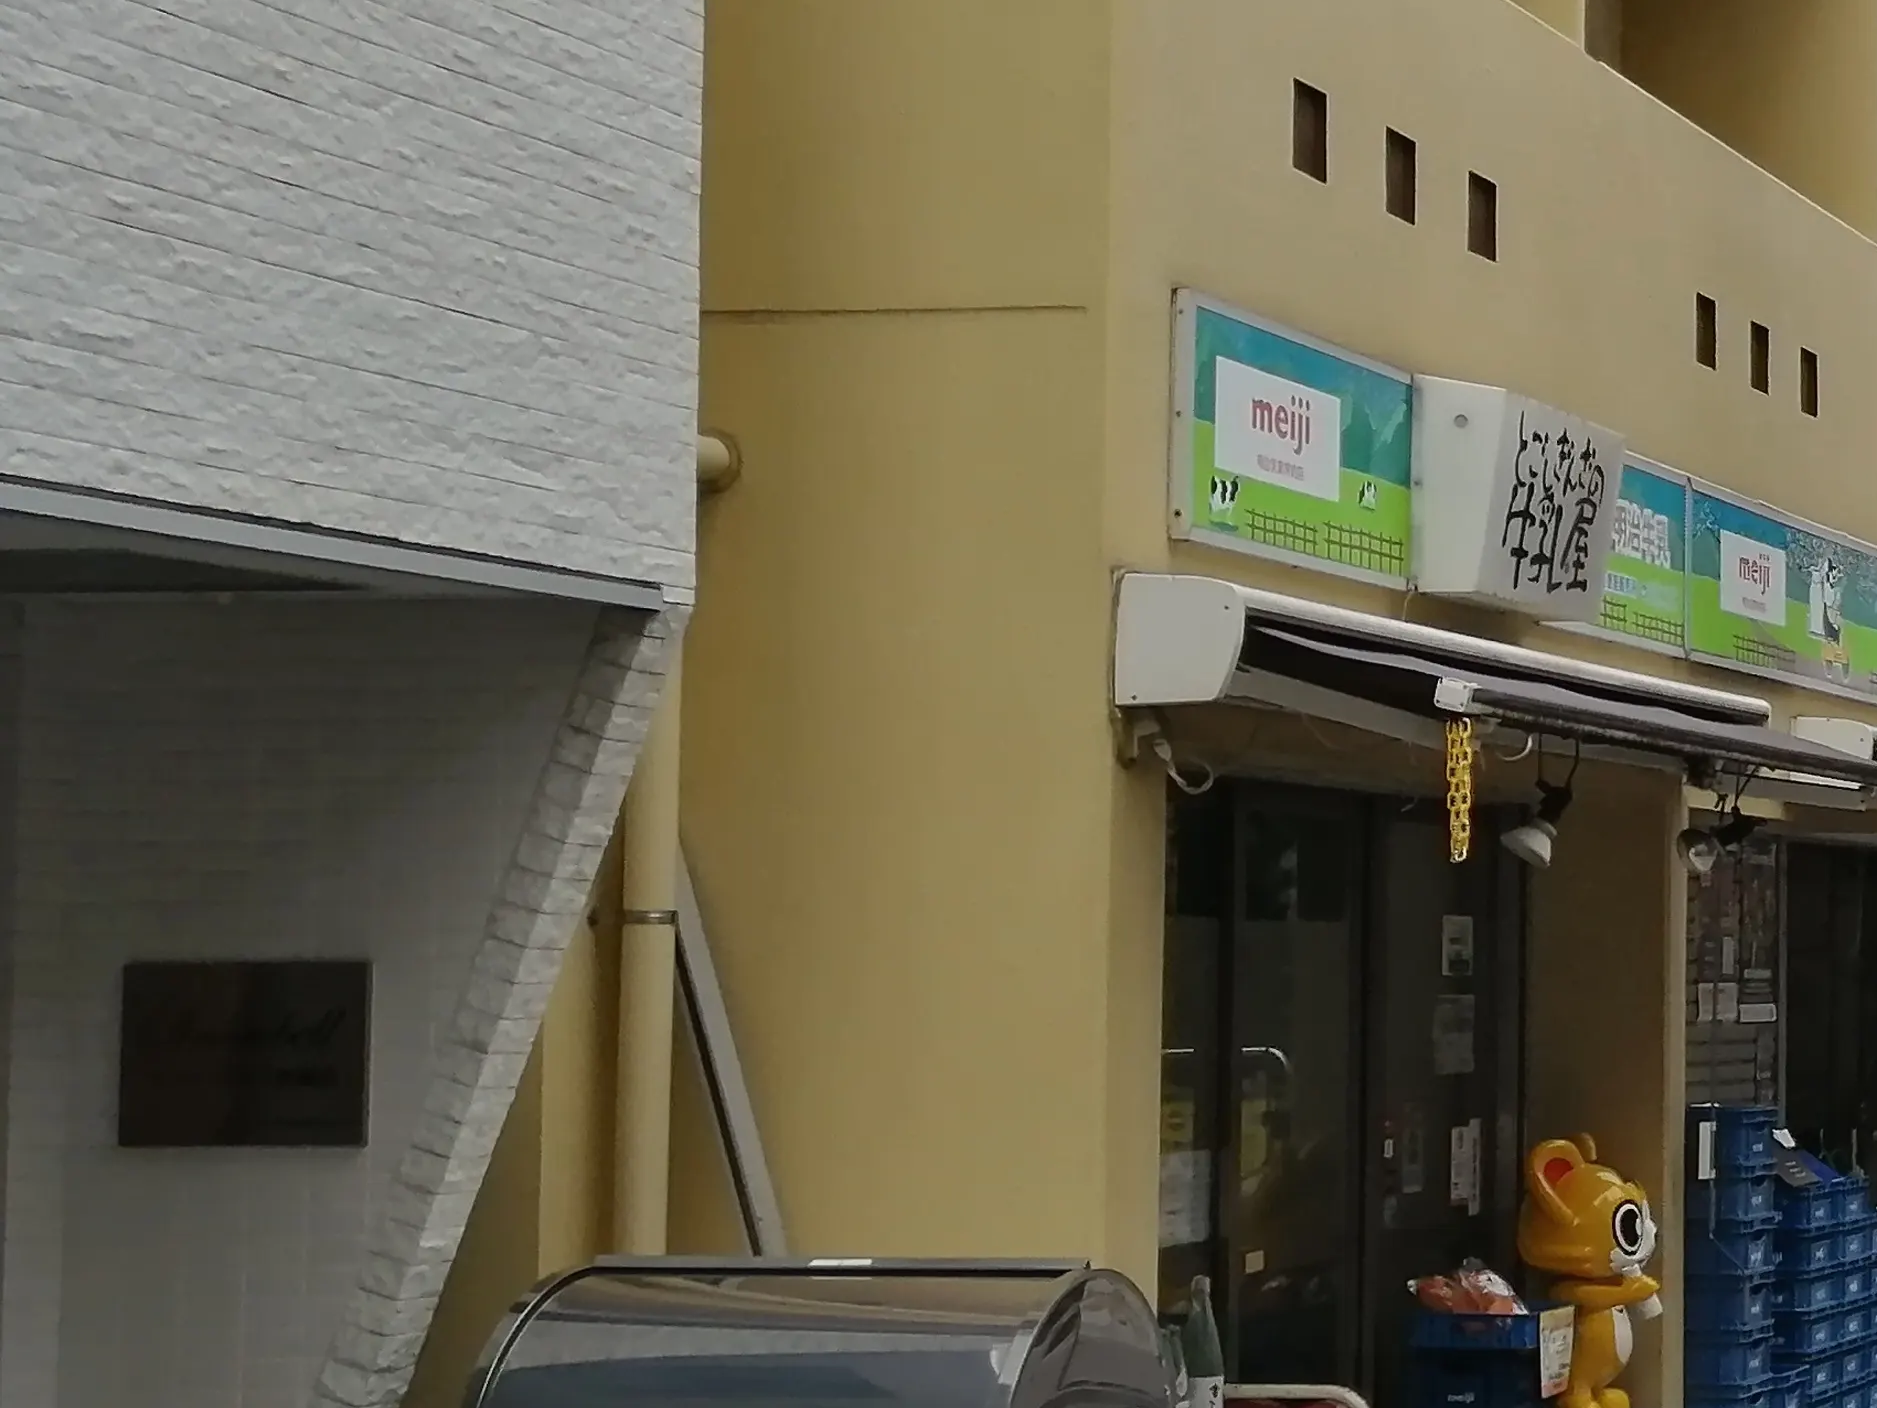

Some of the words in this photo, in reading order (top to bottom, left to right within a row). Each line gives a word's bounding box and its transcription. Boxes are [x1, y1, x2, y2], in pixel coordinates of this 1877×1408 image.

[1251, 394, 1311, 457] meiji
[1501, 484, 1598, 595] 牛乳屋
[1739, 553, 1772, 596] meiji
